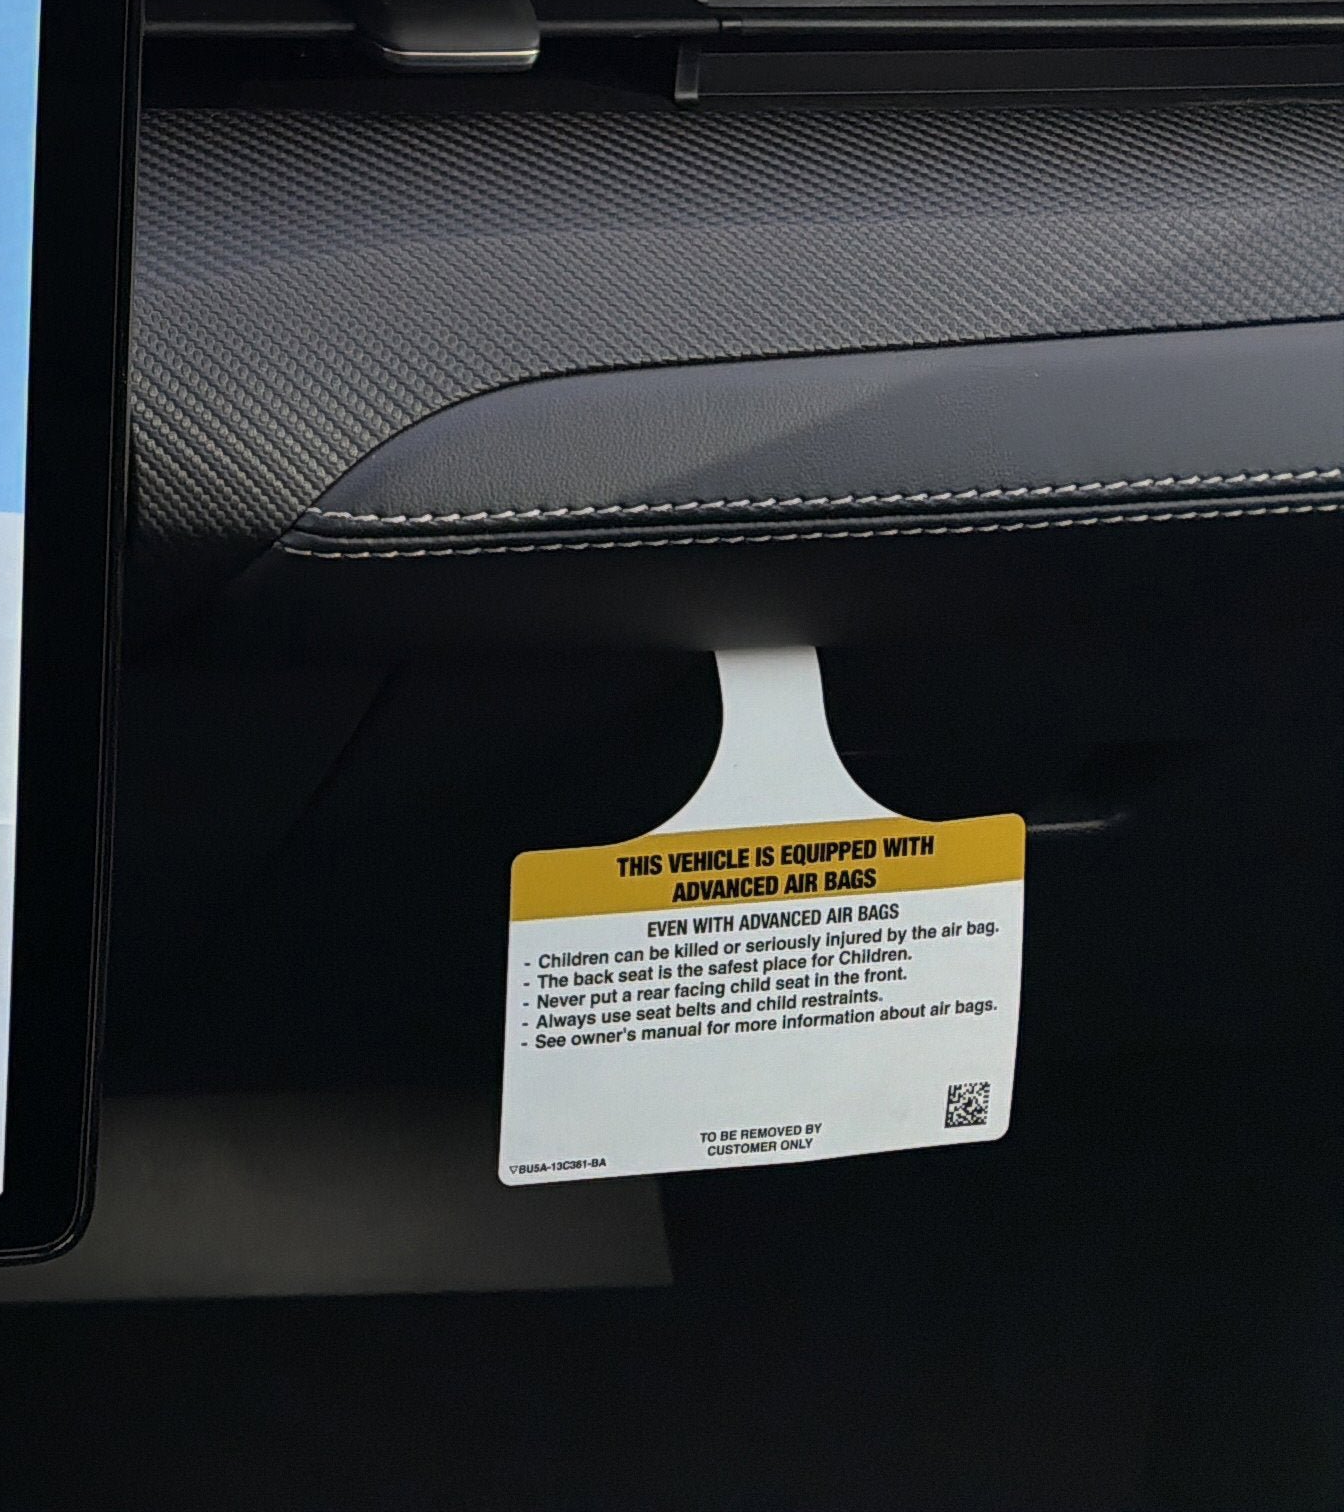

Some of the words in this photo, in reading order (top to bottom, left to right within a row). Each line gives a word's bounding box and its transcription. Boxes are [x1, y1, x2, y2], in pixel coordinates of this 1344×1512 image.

[616, 855, 662, 877] THIS
[668, 848, 749, 873] VEHICLE
[755, 846, 774, 867] IS
[781, 840, 877, 865] EQUIPPED
[883, 836, 934, 857] WITH
[672, 876, 778, 903] ADVANCED
[784, 873, 818, 894] AIR
[824, 868, 876, 891] BAGS
[648, 919, 687, 937] EVEN
[693, 916, 734, 934] WITH
[739, 910, 821, 931] ADVANCED
[826, 907, 852, 924] AIR
[858, 903, 899, 921] BAGS
[539, 952, 608, 969] Children
[615, 950, 643, 963] can
[649, 946, 669, 960] be
[675, 941, 718, 958] killed
[724, 943, 741, 954] or
[746, 934, 821, 952] seriously
[826, 928, 882, 949] injured
[887, 928, 907, 944] by
[912, 926, 937, 940] the
[942, 922, 962, 937] air
[967, 921, 999, 936] bag.
[537, 974, 568, 989] The
[574, 969, 614, 986] back
[618, 967, 653, 982] seat
[659, 965, 672, 979] is
[677, 963, 703, 977] the
[708, 959, 758, 975] safest
[763, 956, 806, 975] place
[811, 953, 834, 967] for
[839, 948, 912, 965] Children.
[537, 994, 586, 1009] Never
[590, 989, 617, 1008] put
[622, 991, 631, 1002] a
[637, 988, 670, 1001] rear
[675, 982, 725, 998] facing
[731, 977, 770, 993] child
[776, 975, 810, 990] seat
[815, 973, 828, 987] in
[834, 971, 859, 985] the
[864, 967, 906, 983] front.
[535, 1034, 566, 1048] See
[571, 1028, 636, 1045] owner's
[642, 1021, 701, 1040] manual
[707, 1021, 730, 1035] for
[735, 1019, 777, 1033] more
[782, 1009, 874, 1029] information
[880, 1004, 926, 1020] about
[930, 1001, 950, 1016] air
[955, 1000, 997, 1015] bags.
[536, 1014, 596, 1029] Always
[602, 1011, 631, 1023] use
[636, 1005, 671, 1020] seat
[676, 1002, 715, 1017] belts
[721, 998, 751, 1014] and
[757, 994, 796, 1011] child
[802, 989, 883, 1008] restraints.
[699, 1131, 717, 1143] TO
[719, 1129, 738, 1142] BE
[740, 1124, 803, 1140] REMOVED
[805, 1122, 823, 1135] BY
[707, 1140, 778, 1157] CUSTOMER
[780, 1137, 814, 1151] ONLY
